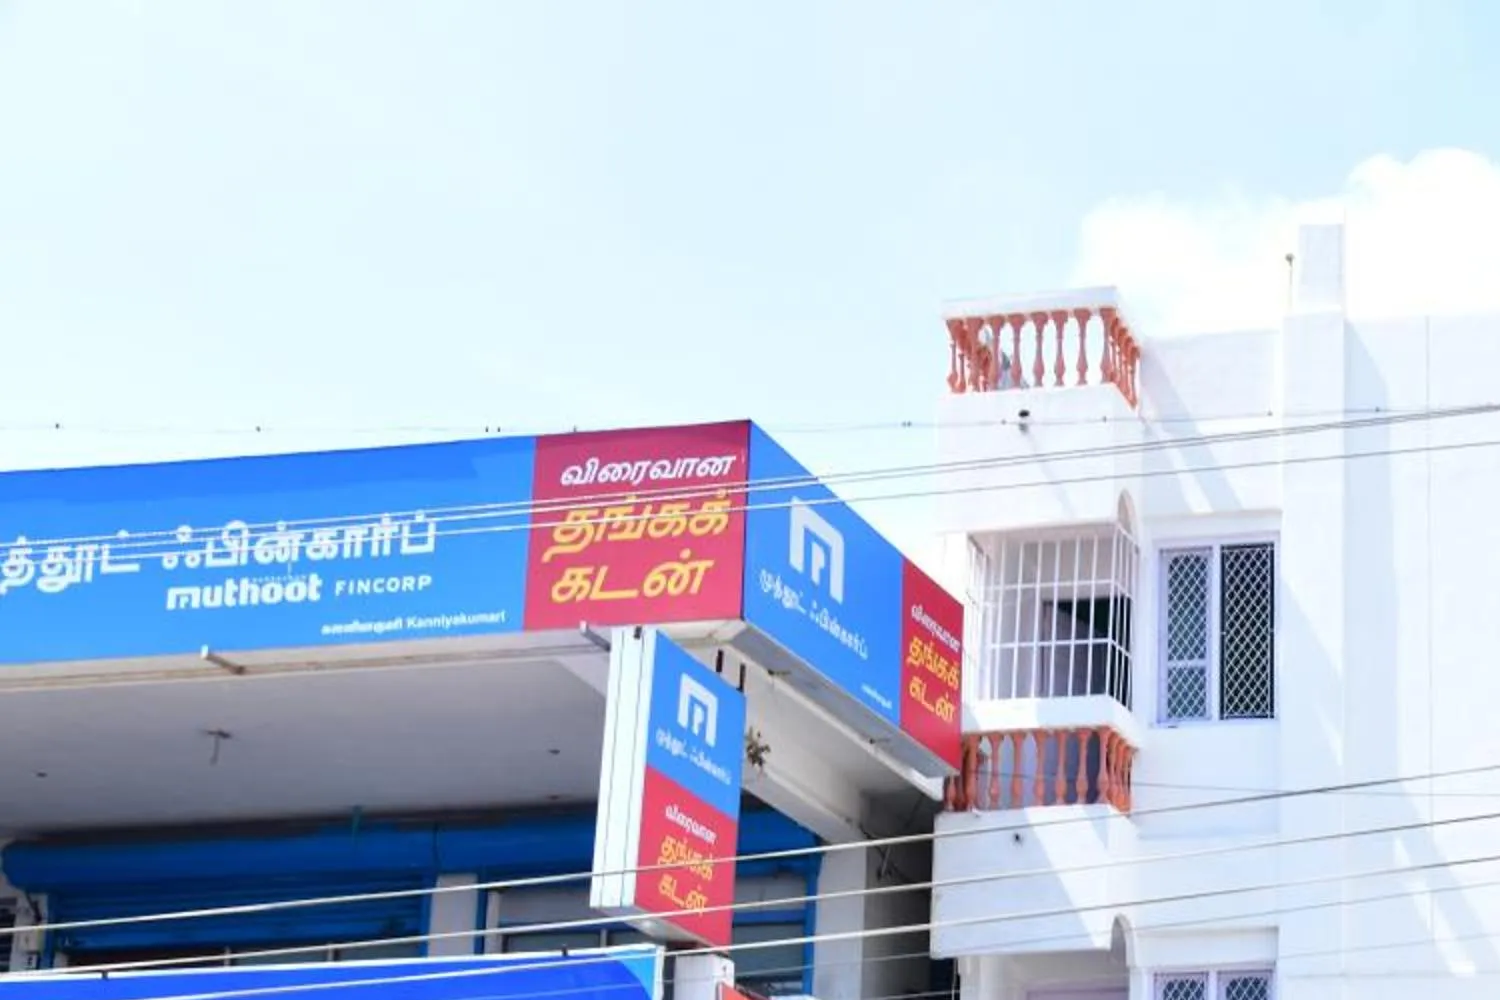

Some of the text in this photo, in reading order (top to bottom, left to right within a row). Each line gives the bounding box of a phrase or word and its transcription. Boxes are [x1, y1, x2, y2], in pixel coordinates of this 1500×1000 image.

[560, 455, 736, 487] விரைவான
[541, 488, 733, 563] தங்கக்
[0, 529, 140, 595] த்தூட்
[551, 548, 714, 603] கடன்
[166, 573, 432, 610] muthoot FINCORP
[909, 675, 955, 722] கடன்
